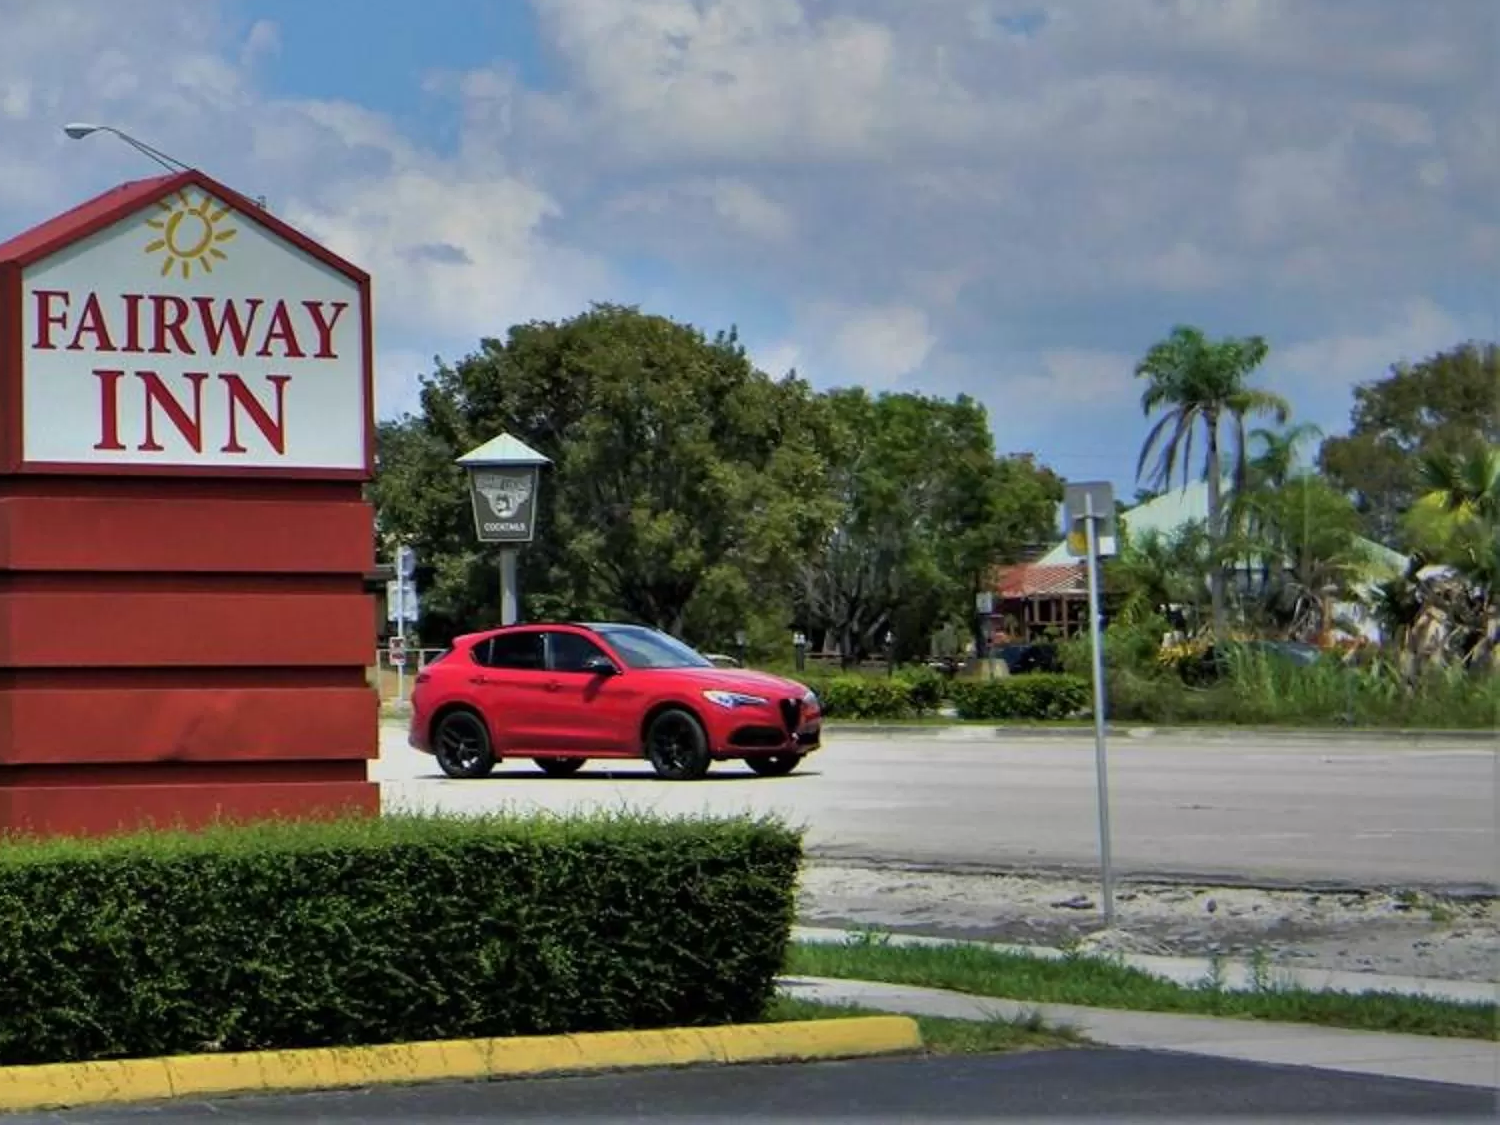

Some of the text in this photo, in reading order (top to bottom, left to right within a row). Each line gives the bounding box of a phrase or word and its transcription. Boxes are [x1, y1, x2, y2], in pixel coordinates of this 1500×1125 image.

[32, 291, 349, 360] FAIRWAY
[93, 369, 291, 455] INN
[483, 522, 527, 532] COCKTAILS
